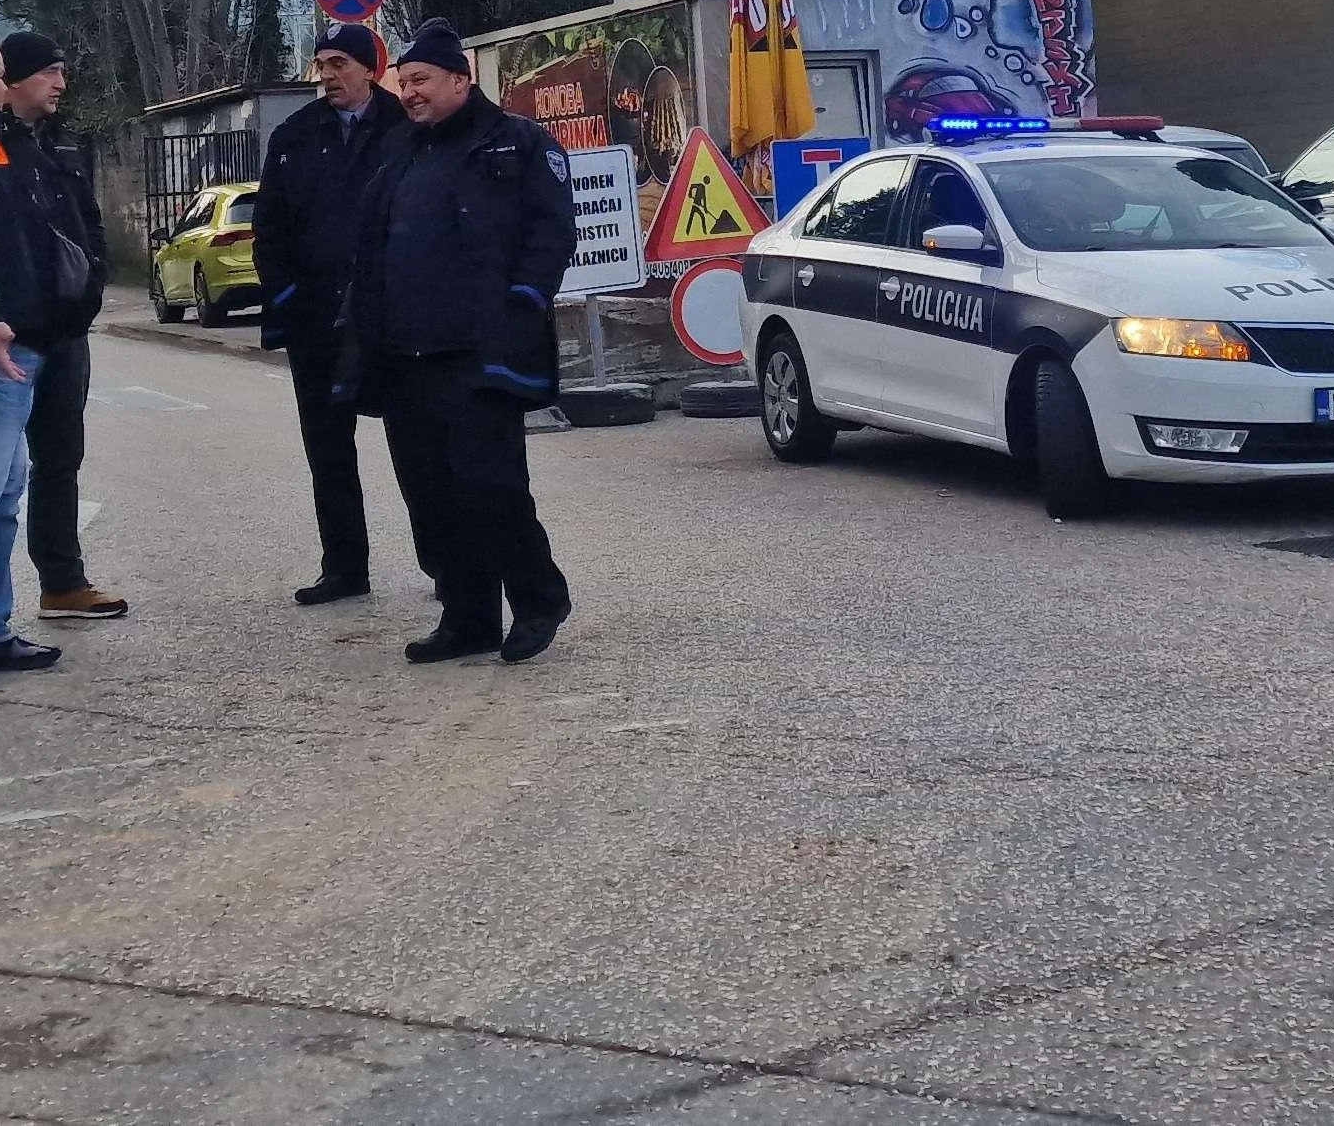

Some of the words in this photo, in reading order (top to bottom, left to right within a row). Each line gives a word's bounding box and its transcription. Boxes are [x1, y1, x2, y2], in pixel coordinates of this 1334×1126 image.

[534, 81, 585, 119] KONOBA
[572, 173, 615, 192] VOREN
[572, 197, 623, 217] BRAĆAJ
[574, 223, 620, 242] RISTITI
[900, 282, 983, 333] POLICIJA
